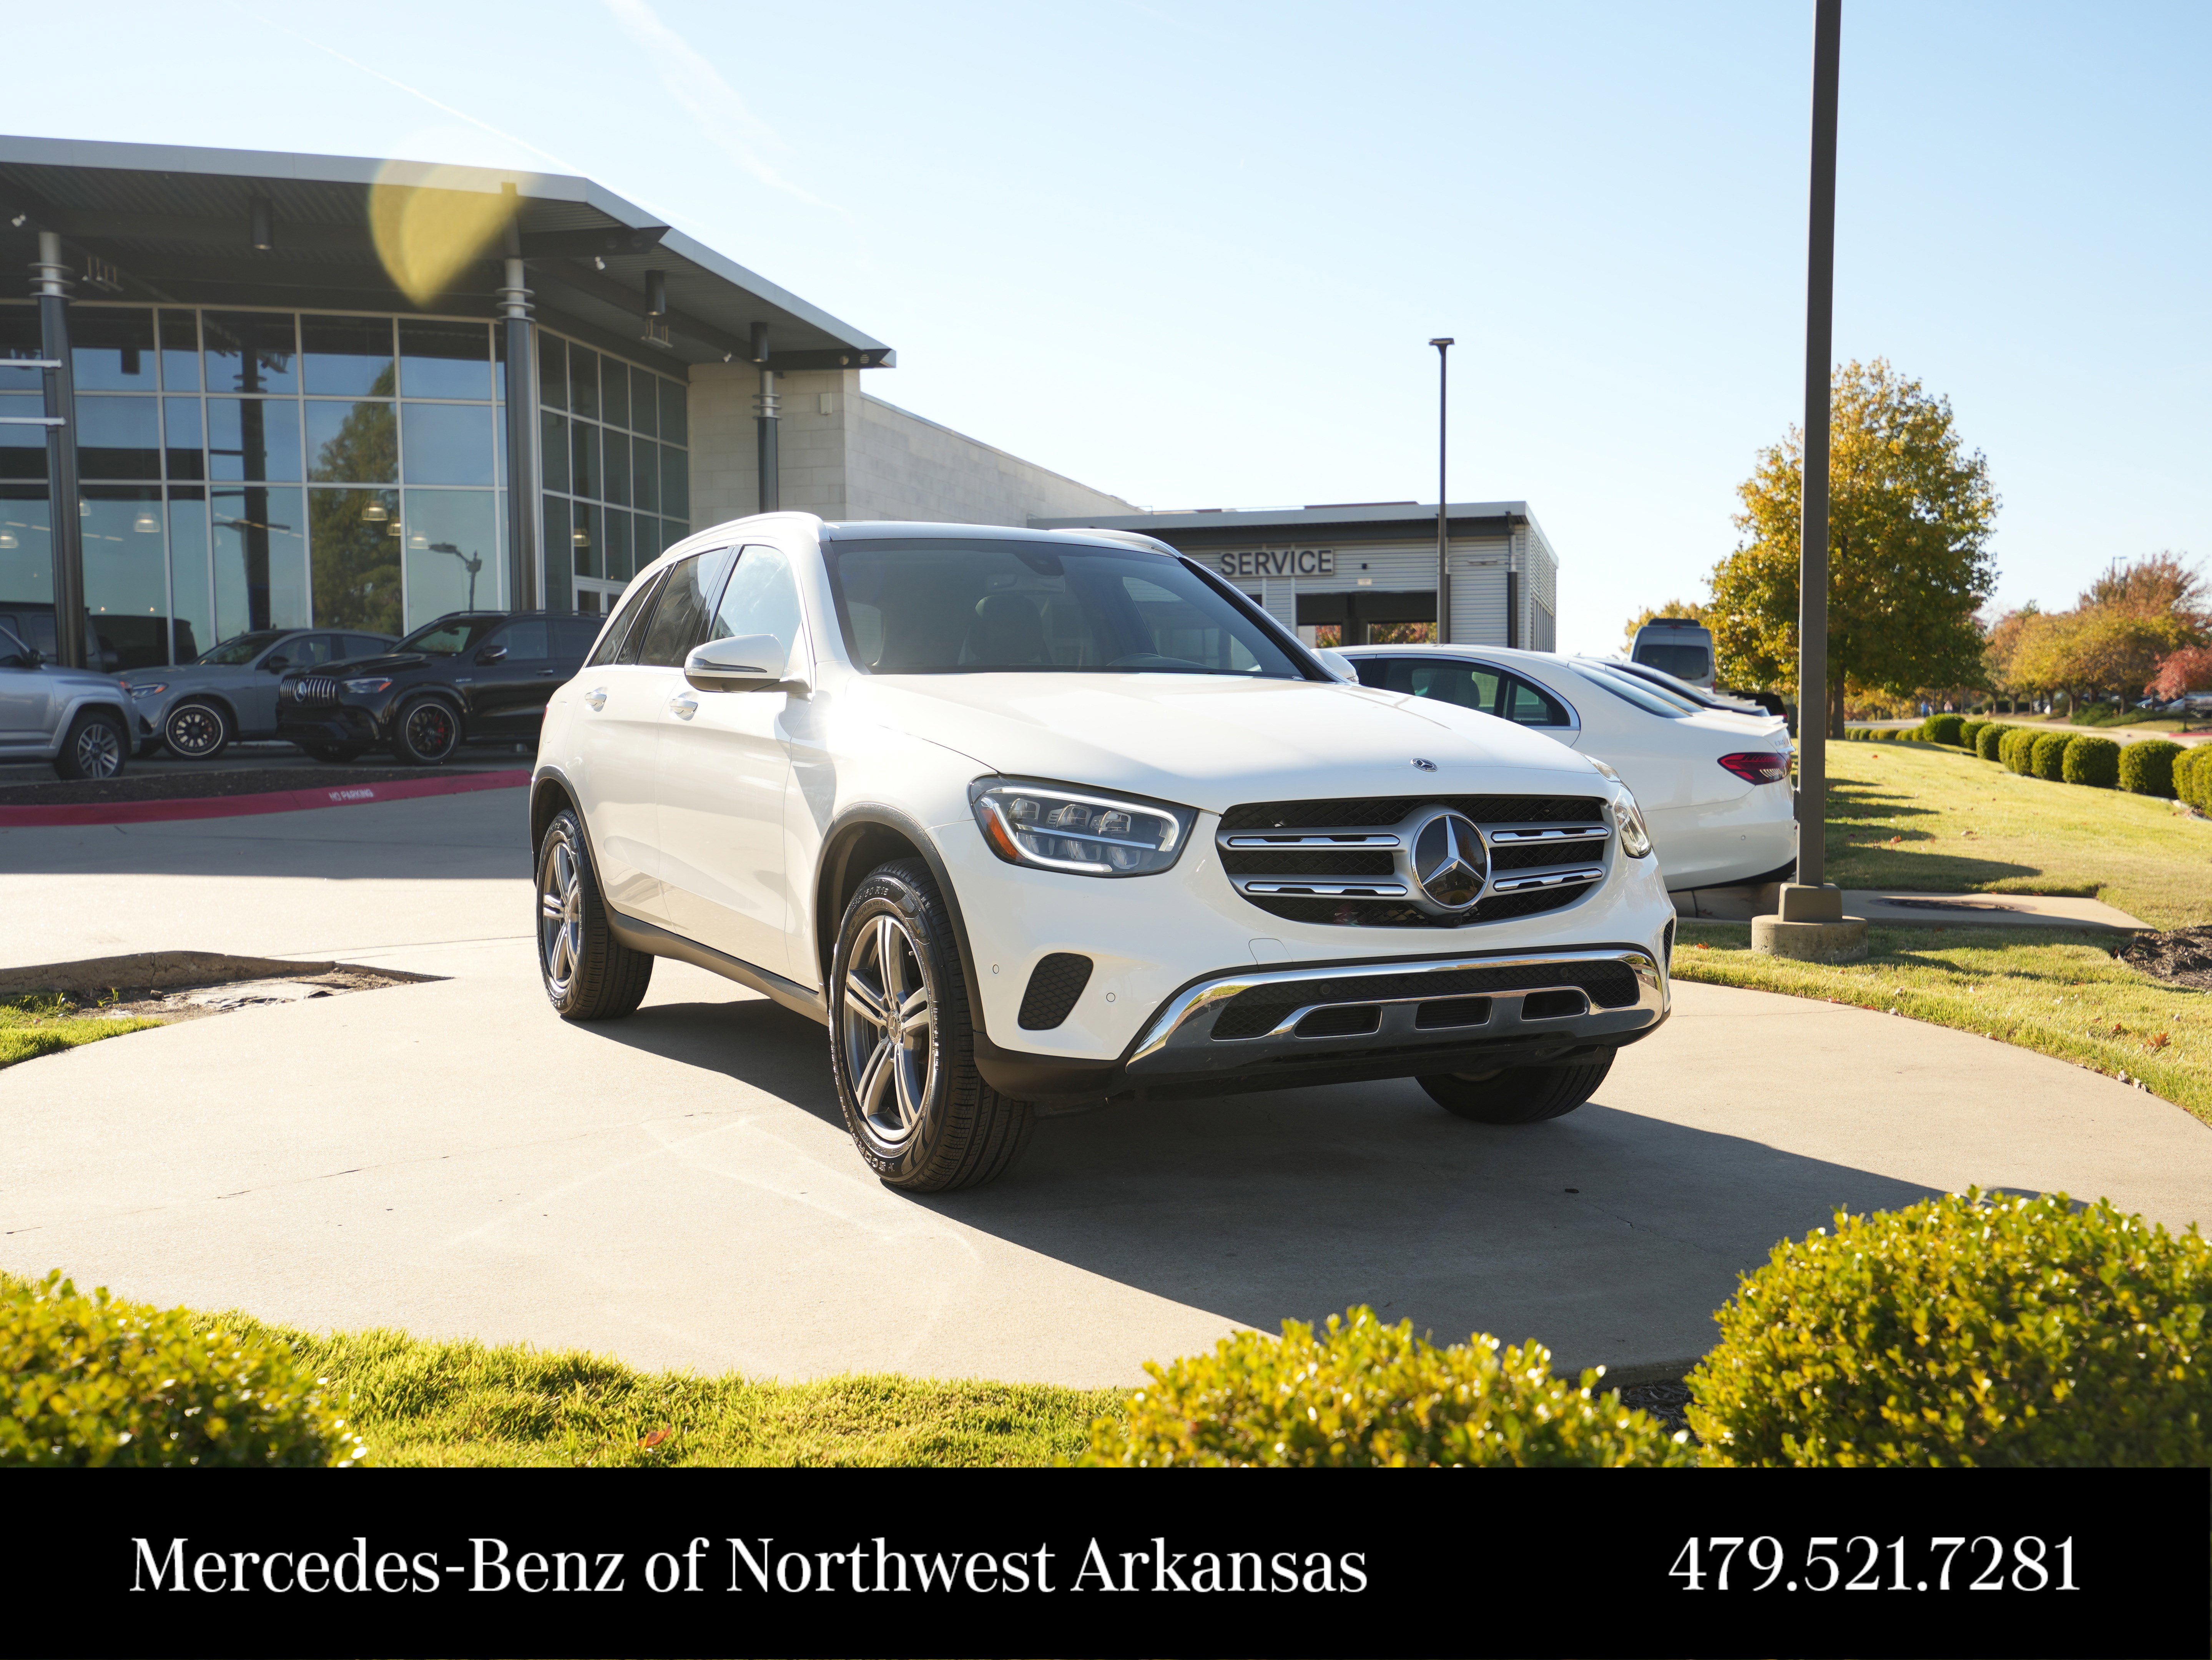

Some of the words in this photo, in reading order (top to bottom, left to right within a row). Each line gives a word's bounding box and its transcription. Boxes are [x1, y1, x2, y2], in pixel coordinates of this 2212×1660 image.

[1220, 550, 1332, 575] SERVICE
[328, 792, 341, 801] NO
[341, 788, 373, 800] PARKING
